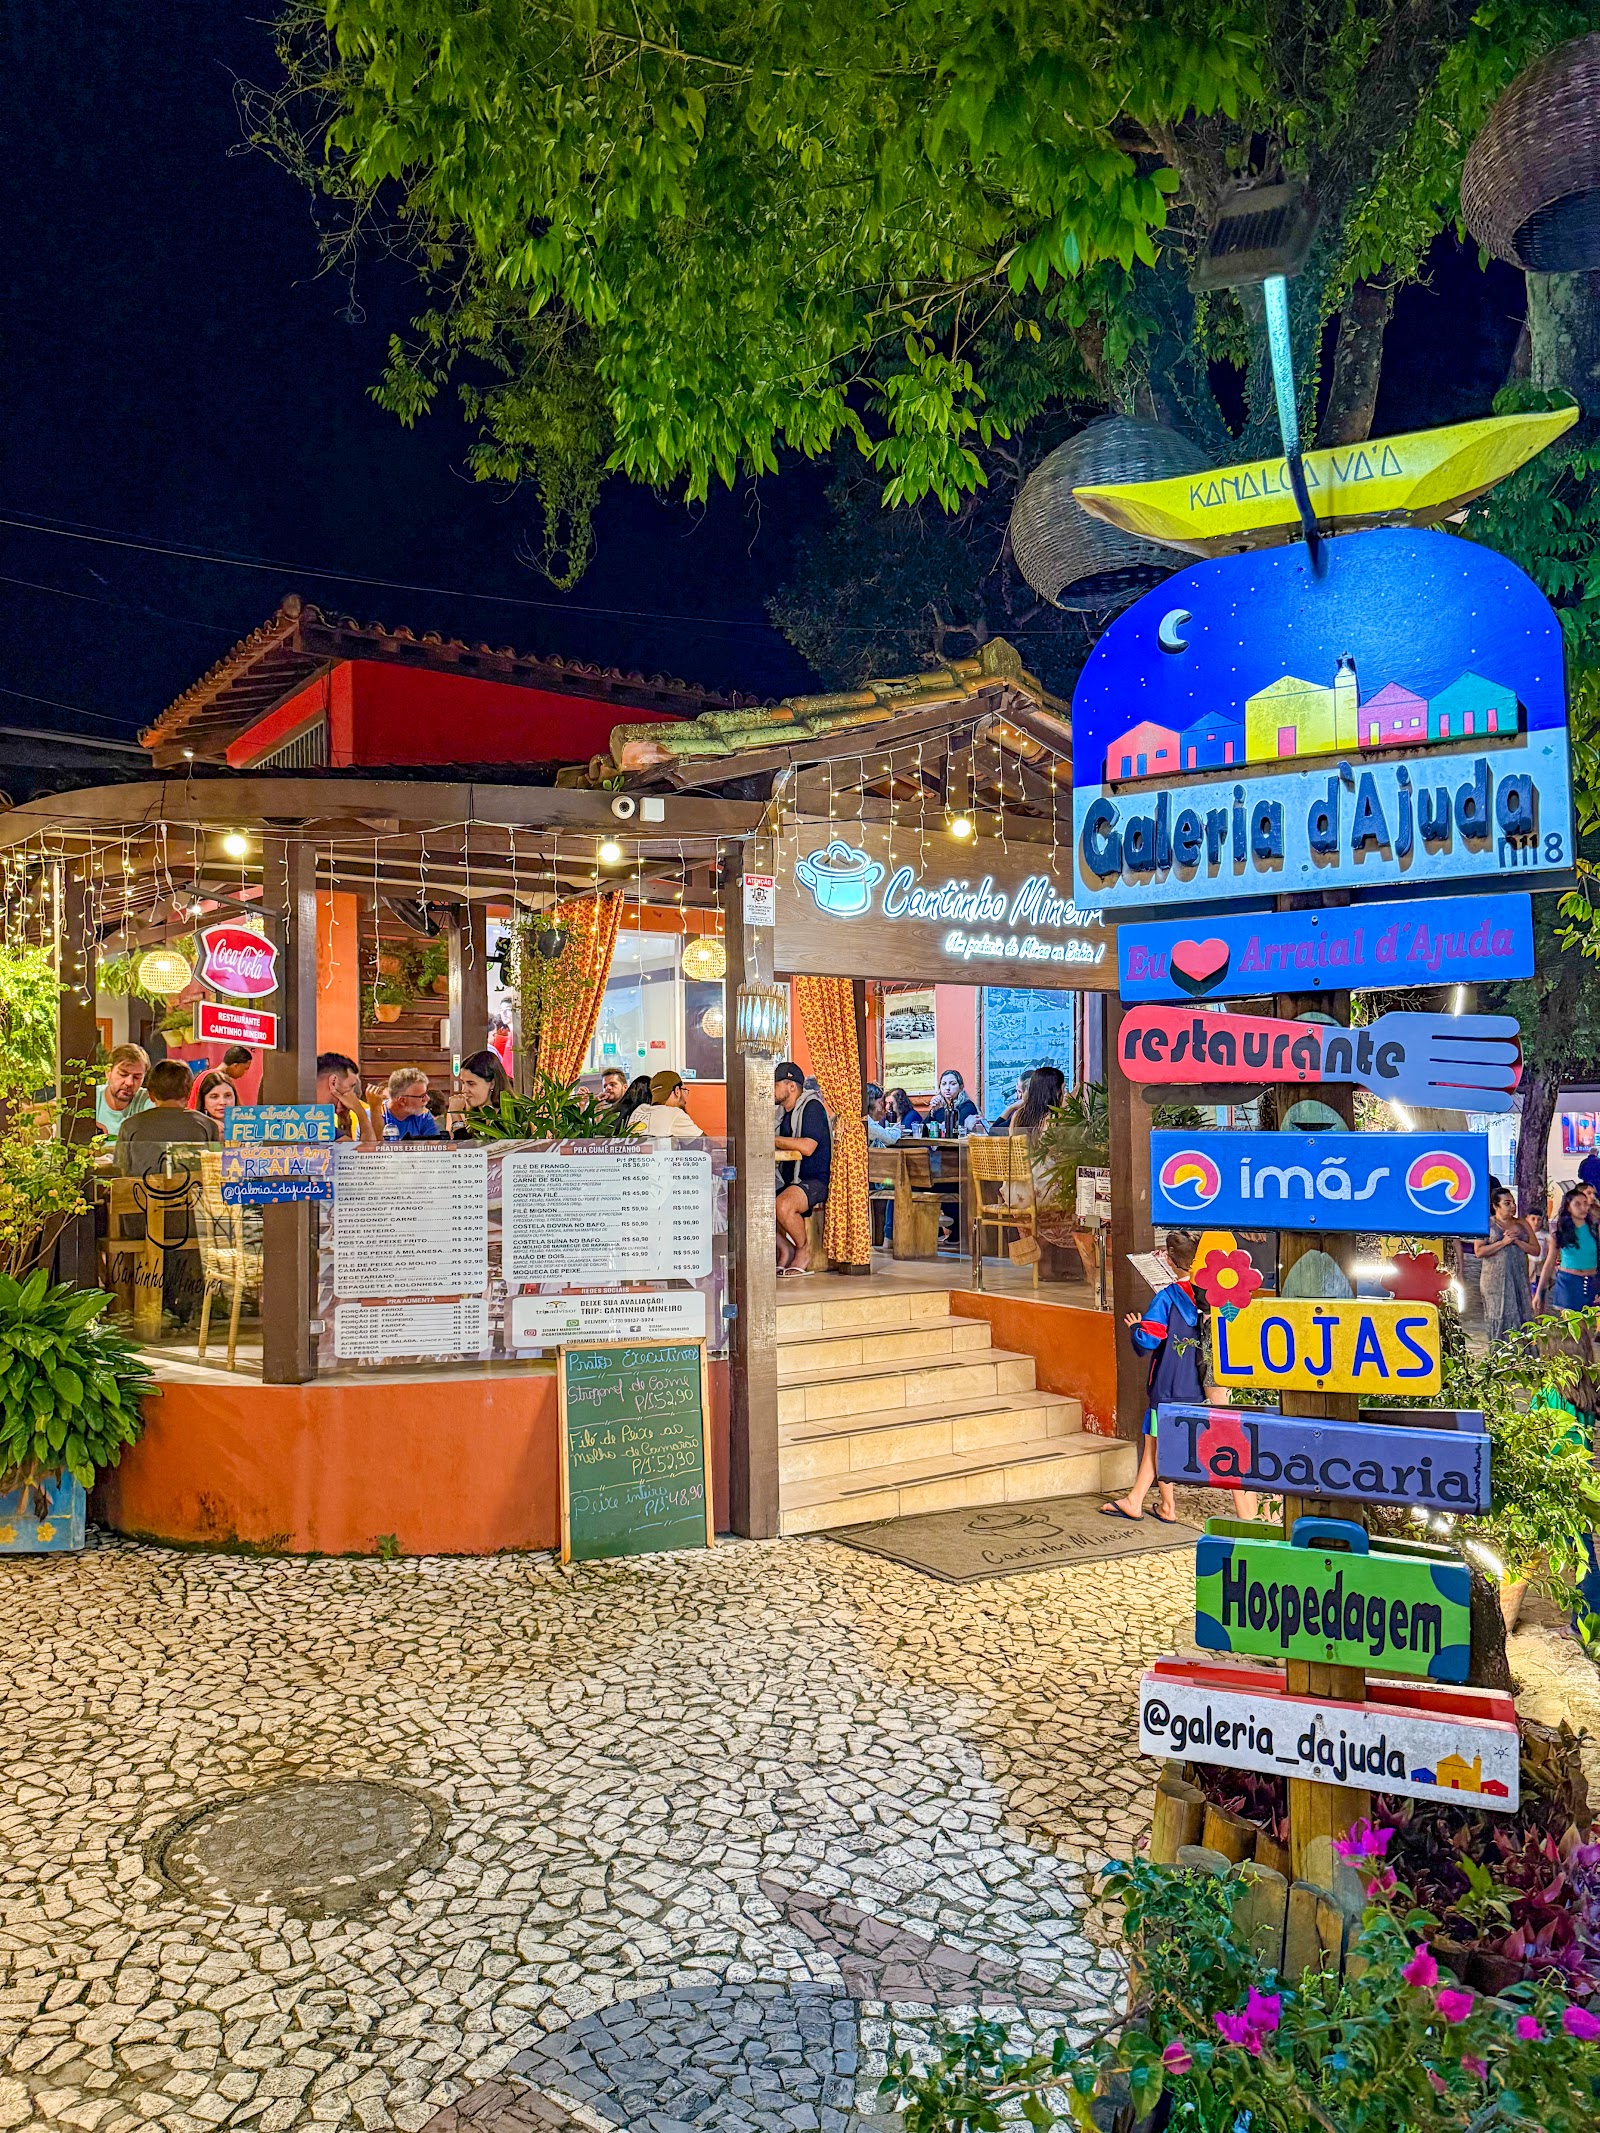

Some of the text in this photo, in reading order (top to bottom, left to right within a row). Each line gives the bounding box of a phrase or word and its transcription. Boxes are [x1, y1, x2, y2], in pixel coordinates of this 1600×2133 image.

[1084, 786, 1284, 877] Galeria
[882, 865, 1005, 921] Cantinho
[212, 938, 266, 980] Coca-Cola
[1019, 936, 1051, 959] Minas
[1065, 940, 1094, 962] Bahia
[1126, 945, 1167, 981] Eu
[1237, 931, 1365, 973] Arraial
[210, 1024, 266, 1041] CANTINHO MINEIRO
[218, 1012, 260, 1027] RESTAURANTE
[1124, 1018, 1405, 1079] restaurante
[231, 1107, 256, 1120] Fui
[227, 1156, 318, 1177] ARRAIAL
[241, 1147, 299, 1160] acabei
[405, 1144, 447, 1152] EXECUTIVOS
[573, 1146, 588, 1154] PRA
[610, 1145, 640, 1153] REZANDO
[1240, 1157, 1390, 1201] ímãs
[604, 1306, 645, 1314] CANTINHO
[1218, 1316, 1434, 1378] LOJAS
[1175, 1416, 1476, 1506] Tabacaria
[981, 1527, 1145, 1565] Cantinho Mineiro
[1222, 1557, 1442, 1656] Hospedagem
[1144, 1699, 1406, 1781] @galeria_dajuda
